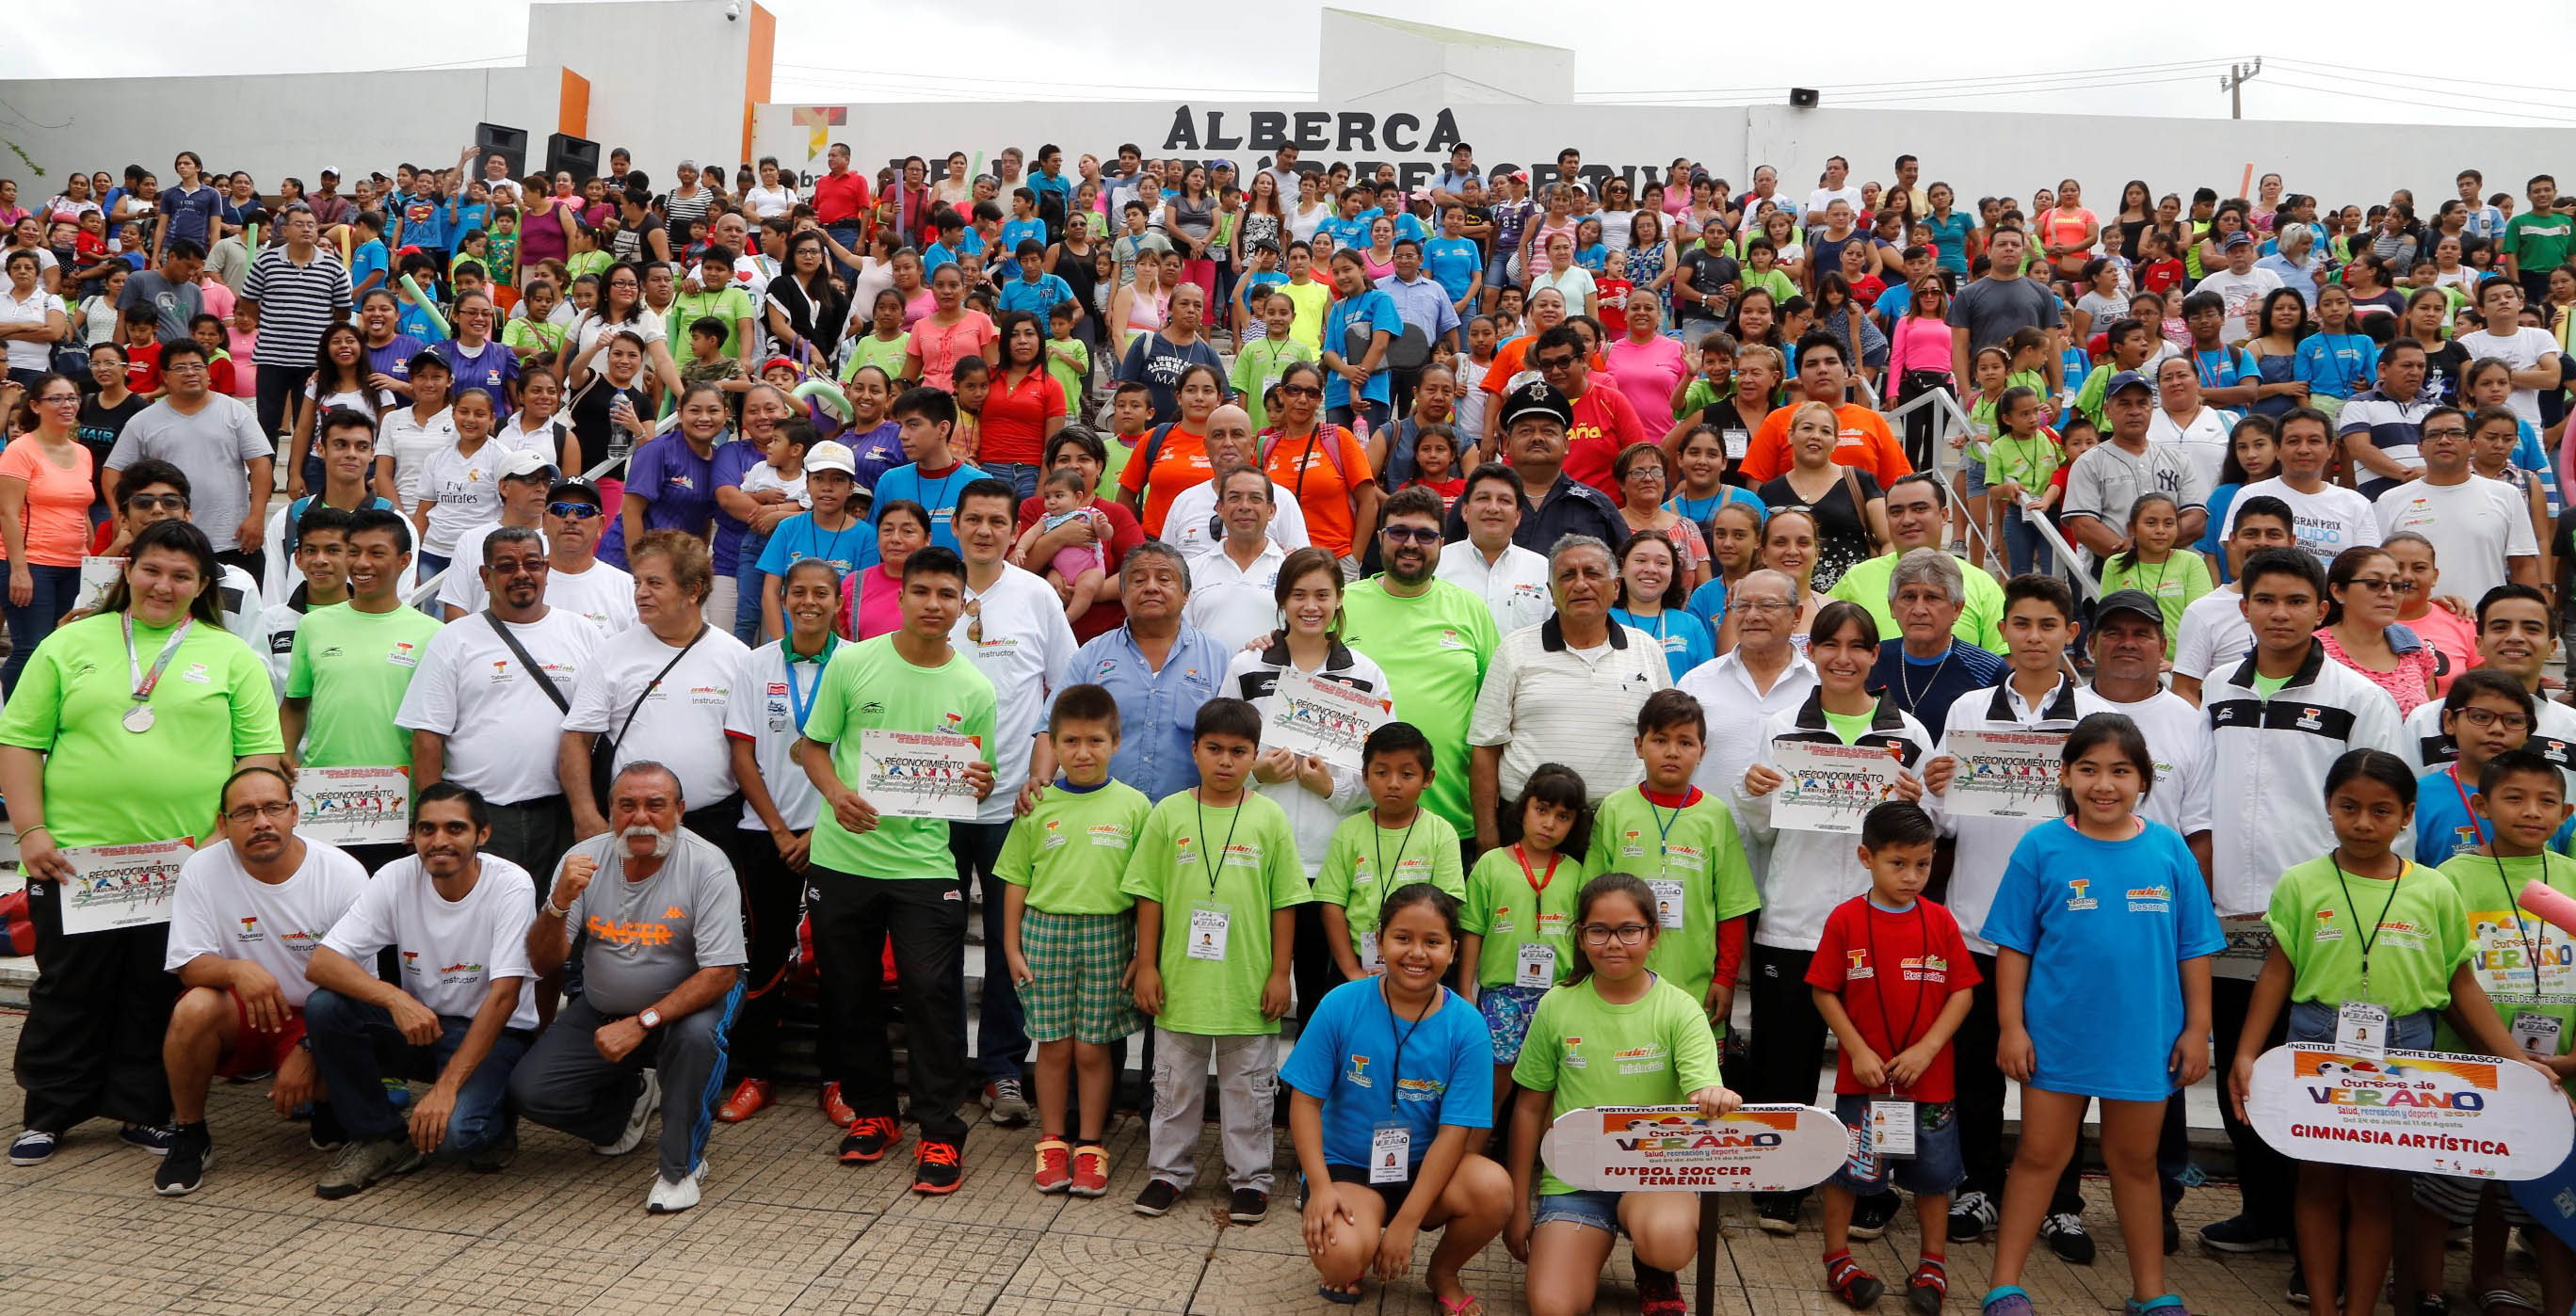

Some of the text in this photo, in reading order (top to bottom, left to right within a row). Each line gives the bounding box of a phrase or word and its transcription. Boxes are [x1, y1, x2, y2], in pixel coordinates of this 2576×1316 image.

[1162, 104, 1461, 152] ALBERCA
[447, 481, 463, 491] Fly
[436, 491, 478, 504] Emirates
[2294, 516, 2342, 530] GRAN PRIX
[2296, 526, 2340, 543] JUDO
[2295, 538, 2317, 548] ORNEO
[979, 650, 1015, 659] Instructor
[692, 697, 726, 705] Instructor
[1296, 698, 1370, 729] RECONOCIMIENTO
[885, 757, 964, 770] RECONOCIMIENTO
[1972, 755, 2061, 768] RECONOCIMIENTO
[1798, 769, 1883, 783] RECONOCIMIENTO
[315, 790, 394, 800] RECONOCIMIENTO
[89, 864, 180, 879] RECONOCIMIENTO
[587, 914, 674, 946] FASTER
[2474, 944, 2573, 971] VERANO
[441, 976, 478, 986] Instructor
[2342, 1011, 2384, 1021] VERANO
[2518, 1022, 2558, 1033] VERANO
[2288, 1042, 2504, 1064] INSTITUT EPORTE DE TABASCO
[2341, 1078, 2436, 1090] Cursos de
[2308, 1086, 2485, 1111] VERANO
[2337, 1106, 2438, 1119] Salud, recreación y deporte
[1649, 1128, 1740, 1138] Cursos de
[1615, 1132, 1782, 1151] VERANO
[2291, 1124, 2510, 1157] GIMNASIA ARTÍSTICA
[1604, 1166, 1752, 1176] FUTBOL SOCCER
[1639, 1176, 1716, 1186] FEMENIL
